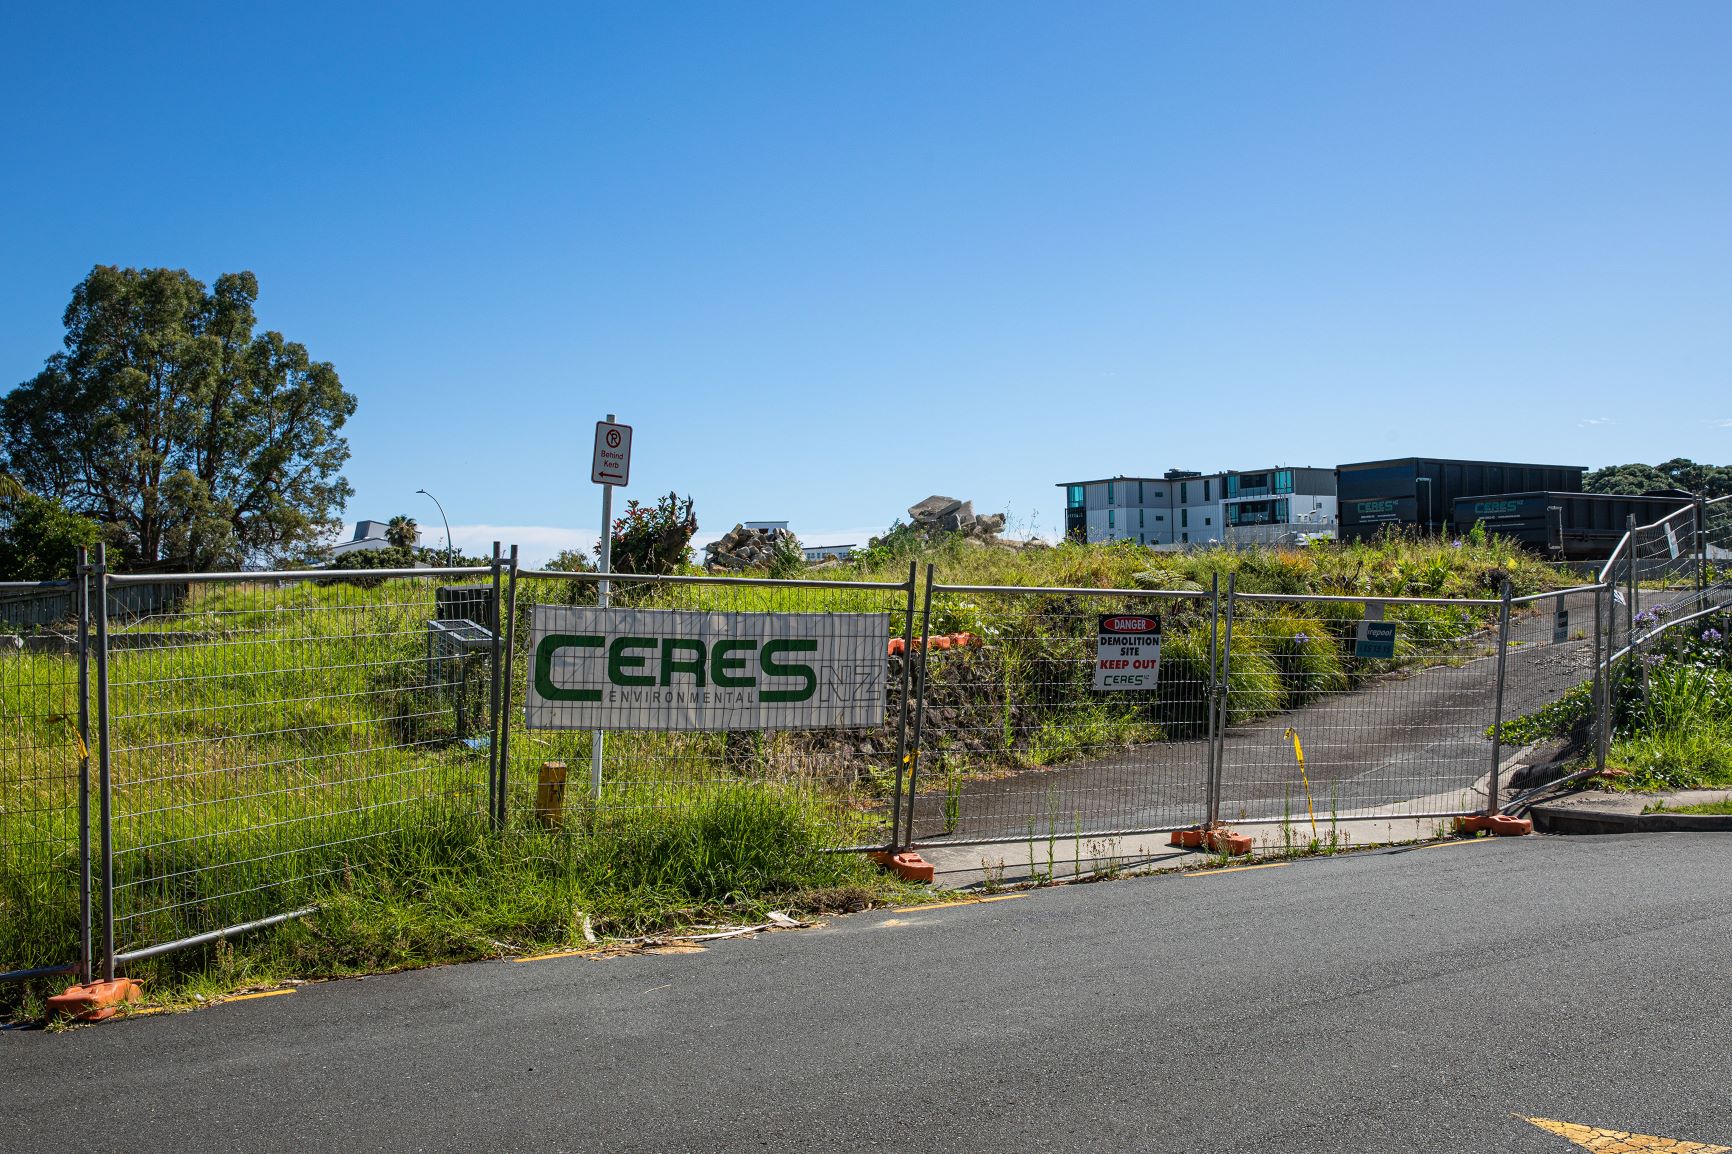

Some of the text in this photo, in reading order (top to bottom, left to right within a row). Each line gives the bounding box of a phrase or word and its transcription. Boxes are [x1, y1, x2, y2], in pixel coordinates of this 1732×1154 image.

[601, 450, 624, 460] Behind
[604, 460, 620, 469] Kerb
[1357, 500, 1393, 513] CERES
[1474, 500, 1517, 513] CERES
[1114, 619, 1147, 630] DANGER
[1100, 636, 1160, 646] DEMOLITION
[1120, 647, 1140, 656] SITE
[535, 634, 882, 702] CERES NZ
[1100, 660, 1157, 669] KEEP OUT
[1104, 675, 1143, 686] CERES
[609, 690, 754, 703] ENVIRONMENTAL
